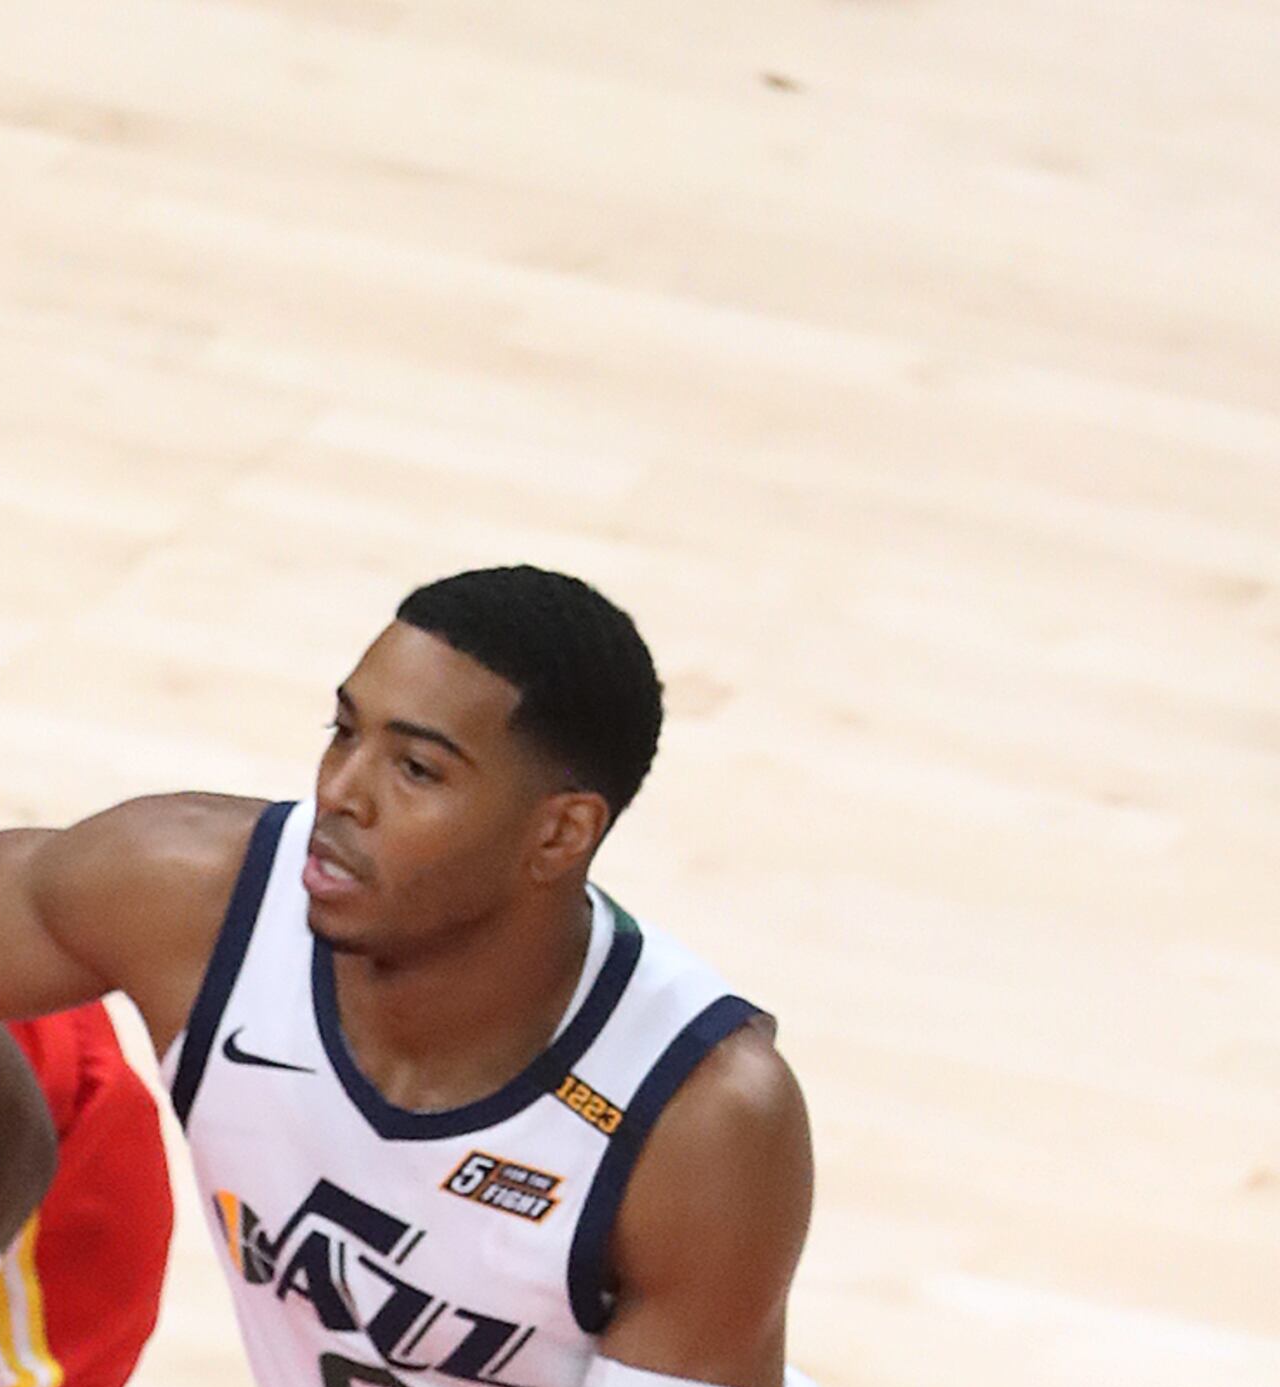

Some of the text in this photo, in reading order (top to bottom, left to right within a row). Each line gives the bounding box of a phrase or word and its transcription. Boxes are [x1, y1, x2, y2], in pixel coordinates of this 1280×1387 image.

[555, 1075, 623, 1134] 1223
[451, 1154, 497, 1197] 5
[480, 1183, 550, 1218] FIGHT
